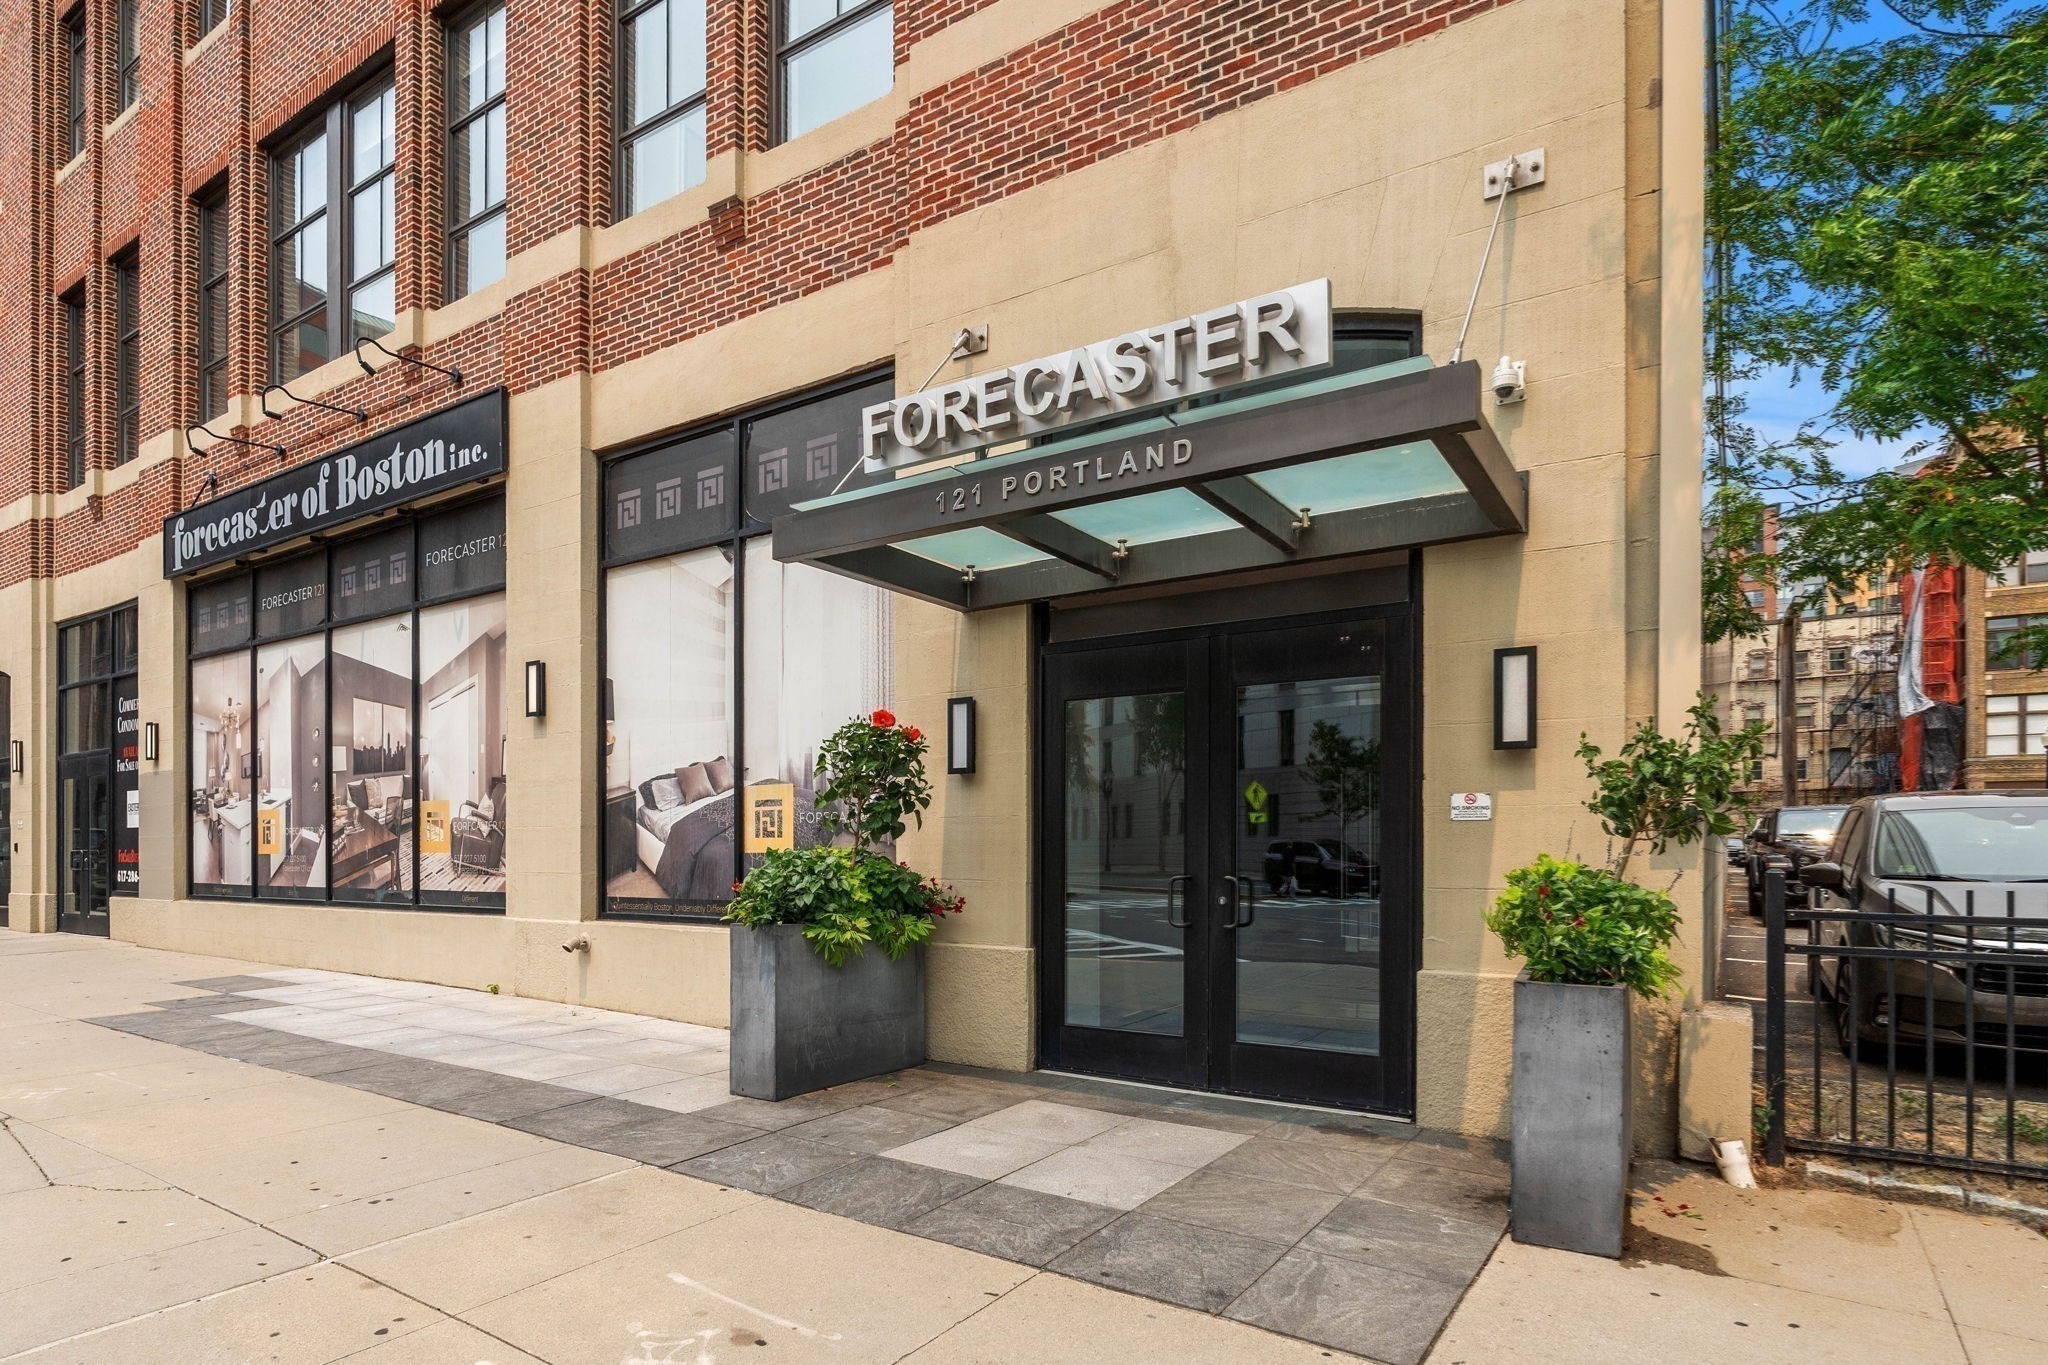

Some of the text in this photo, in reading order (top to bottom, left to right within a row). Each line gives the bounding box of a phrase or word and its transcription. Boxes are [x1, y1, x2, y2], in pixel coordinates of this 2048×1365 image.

[862, 291, 1304, 461] FORECASTER
[301, 462, 331, 520] of
[335, 438, 448, 511] Boston
[449, 443, 488, 472] inc.
[935, 438, 1194, 513] 121 PORTLAND
[425, 535, 496, 568] FORECASTER
[262, 583, 326, 611] FORECASTER 121
